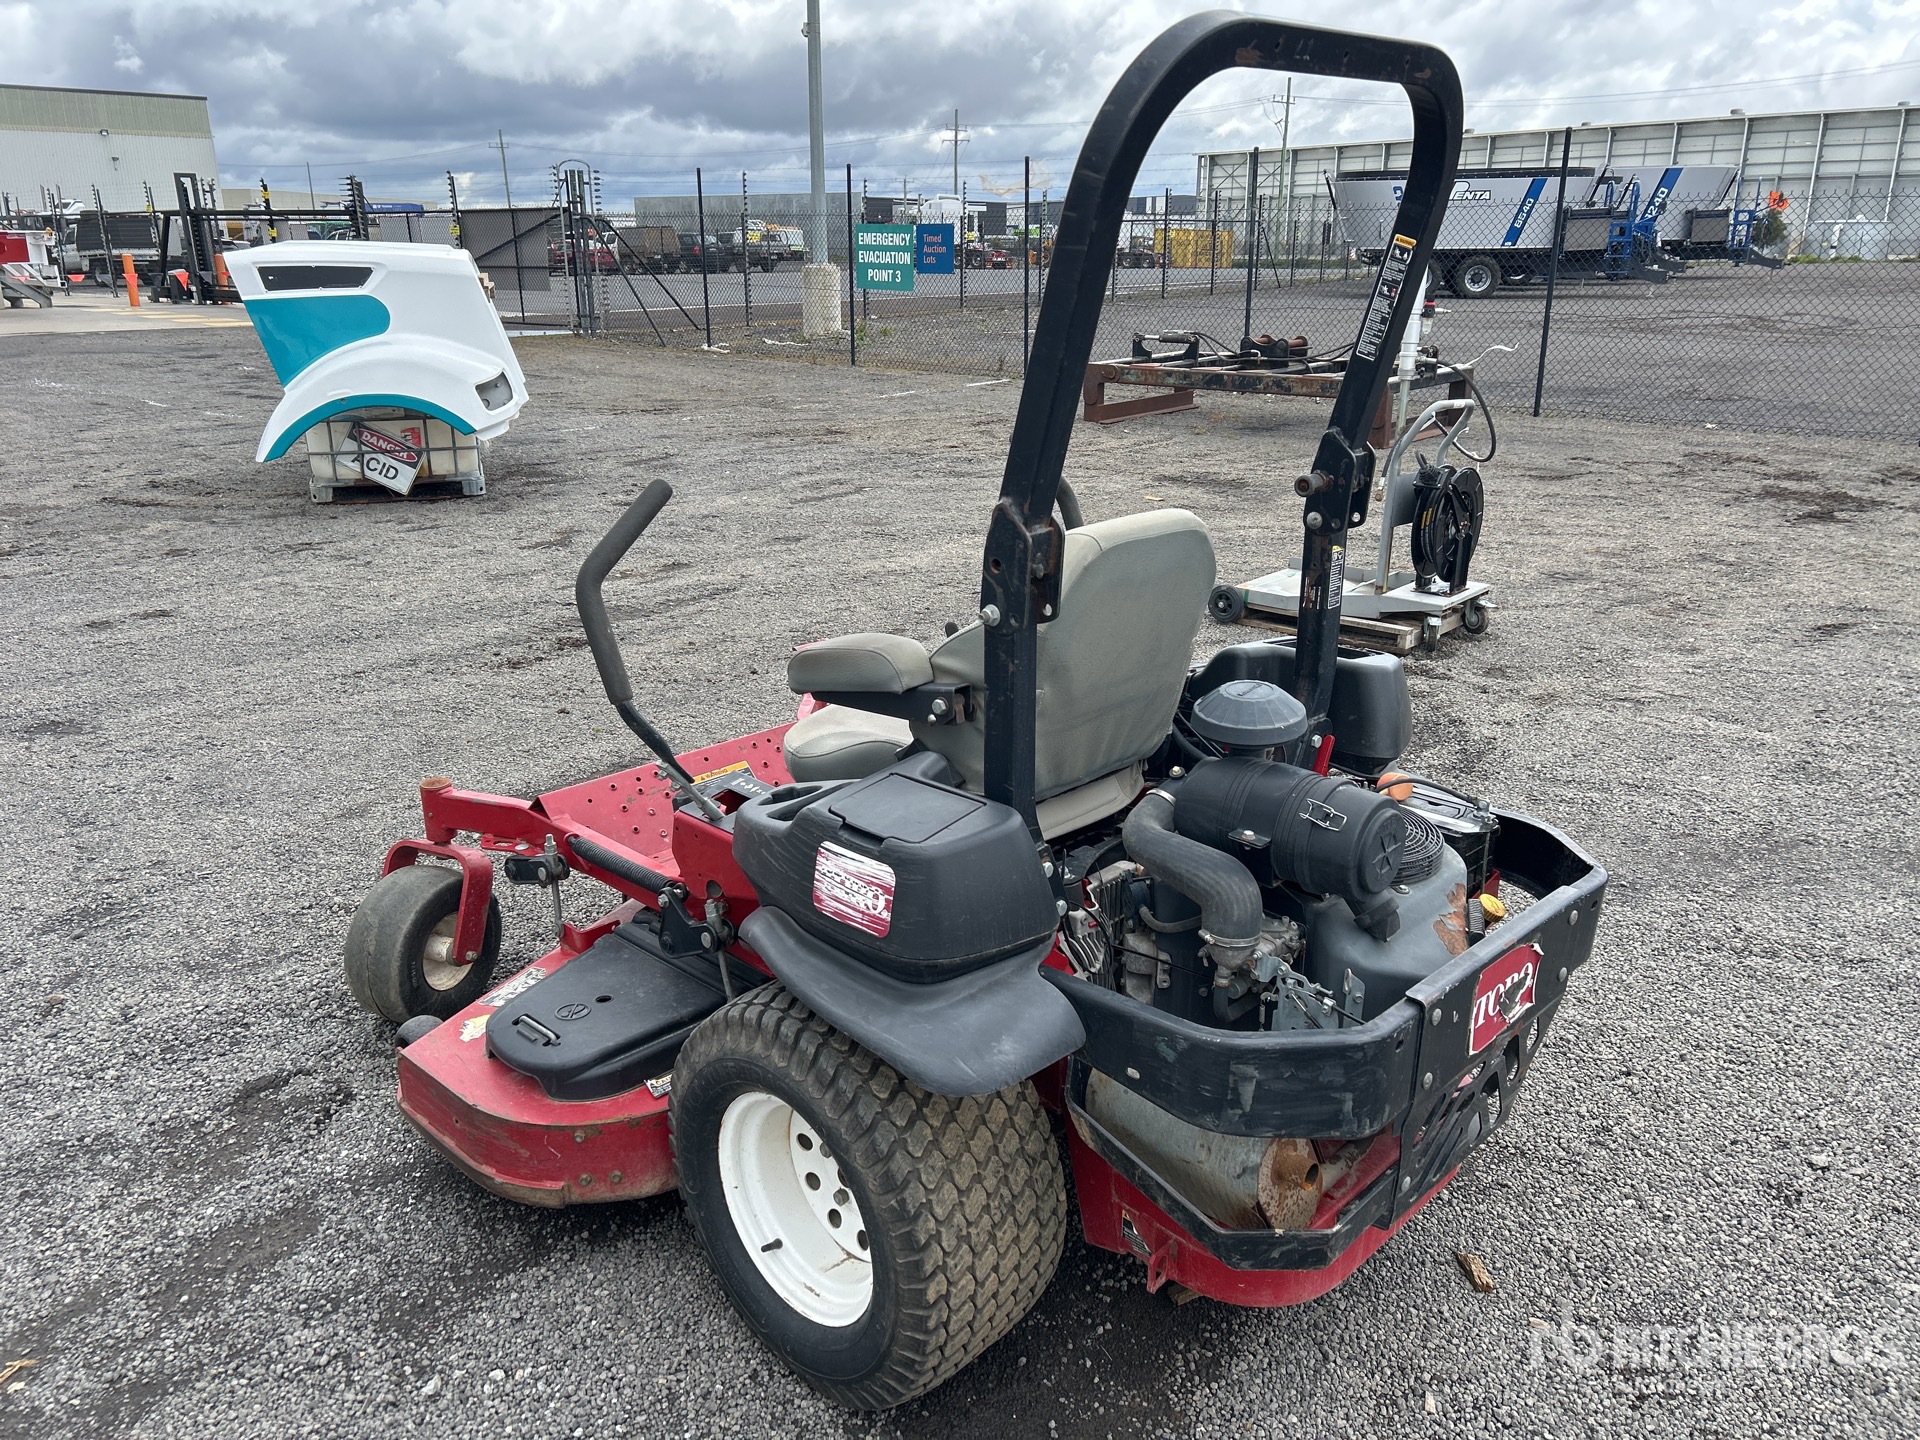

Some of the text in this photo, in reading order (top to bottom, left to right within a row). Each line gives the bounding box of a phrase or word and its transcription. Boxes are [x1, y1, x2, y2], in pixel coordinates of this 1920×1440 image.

[1449, 181, 1491, 200] PENTA
[1514, 198, 1534, 228] 8540
[858, 232, 911, 246] EMERGENCY
[923, 234, 942, 242] Timed
[923, 244, 946, 253] Auction
[858, 251, 911, 264] EVACUATION
[923, 255, 936, 264] Lots
[867, 269, 902, 283] POINT 3
